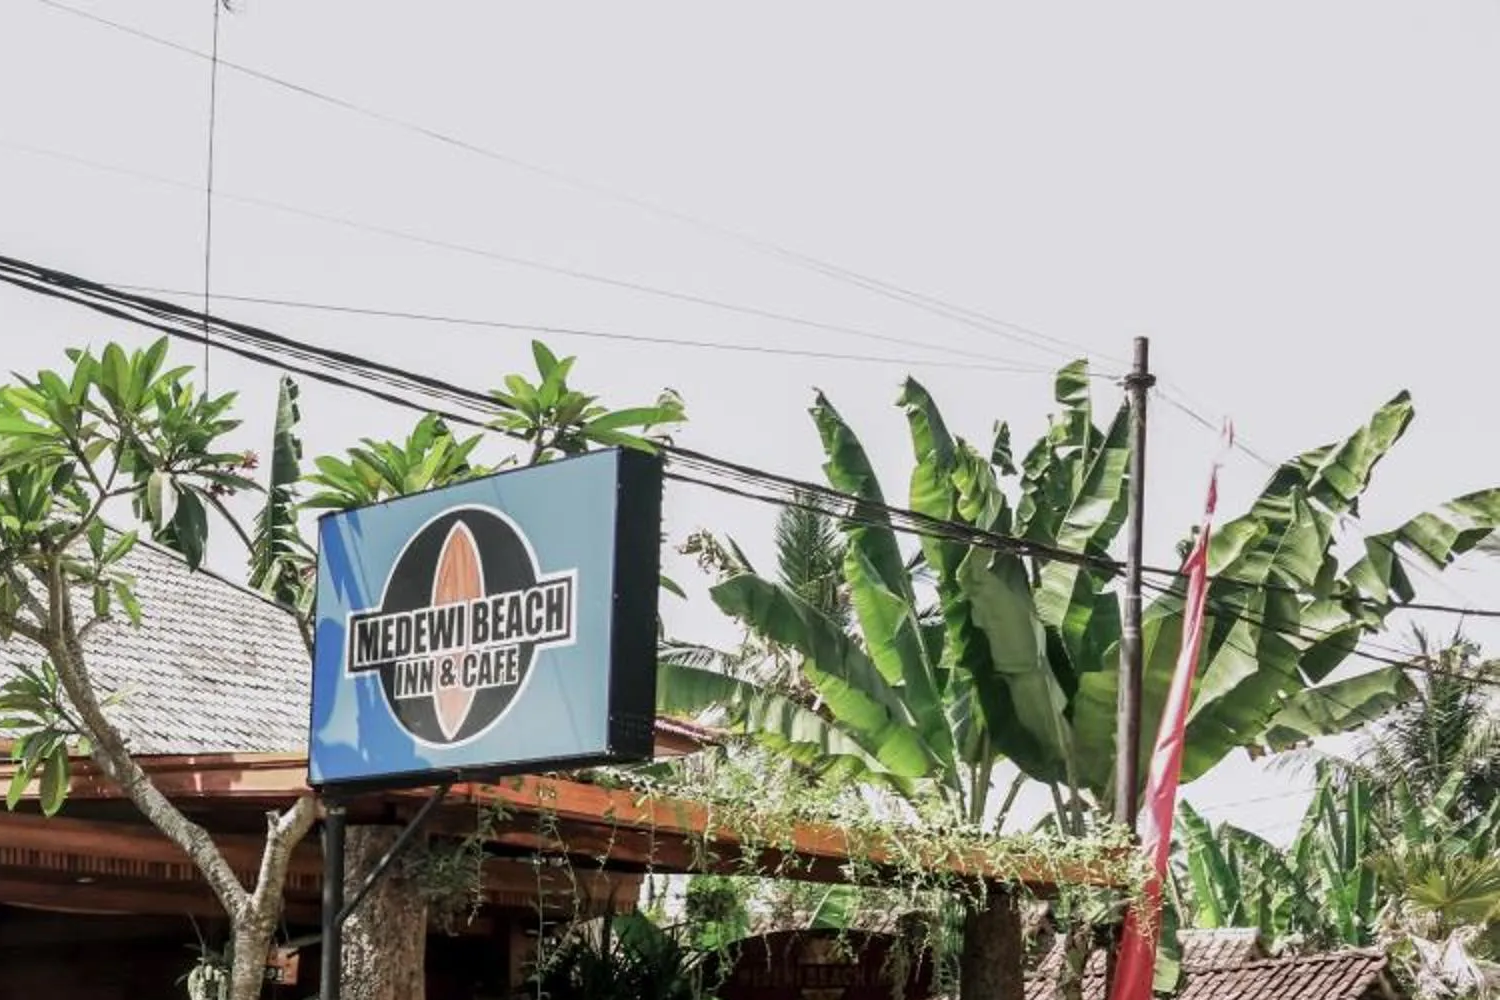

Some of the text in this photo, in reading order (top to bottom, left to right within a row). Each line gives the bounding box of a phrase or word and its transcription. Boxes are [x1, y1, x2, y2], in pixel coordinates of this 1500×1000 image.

[356, 585, 565, 663] MEDEWI BEACH
[395, 649, 518, 697] INN & CAFE
